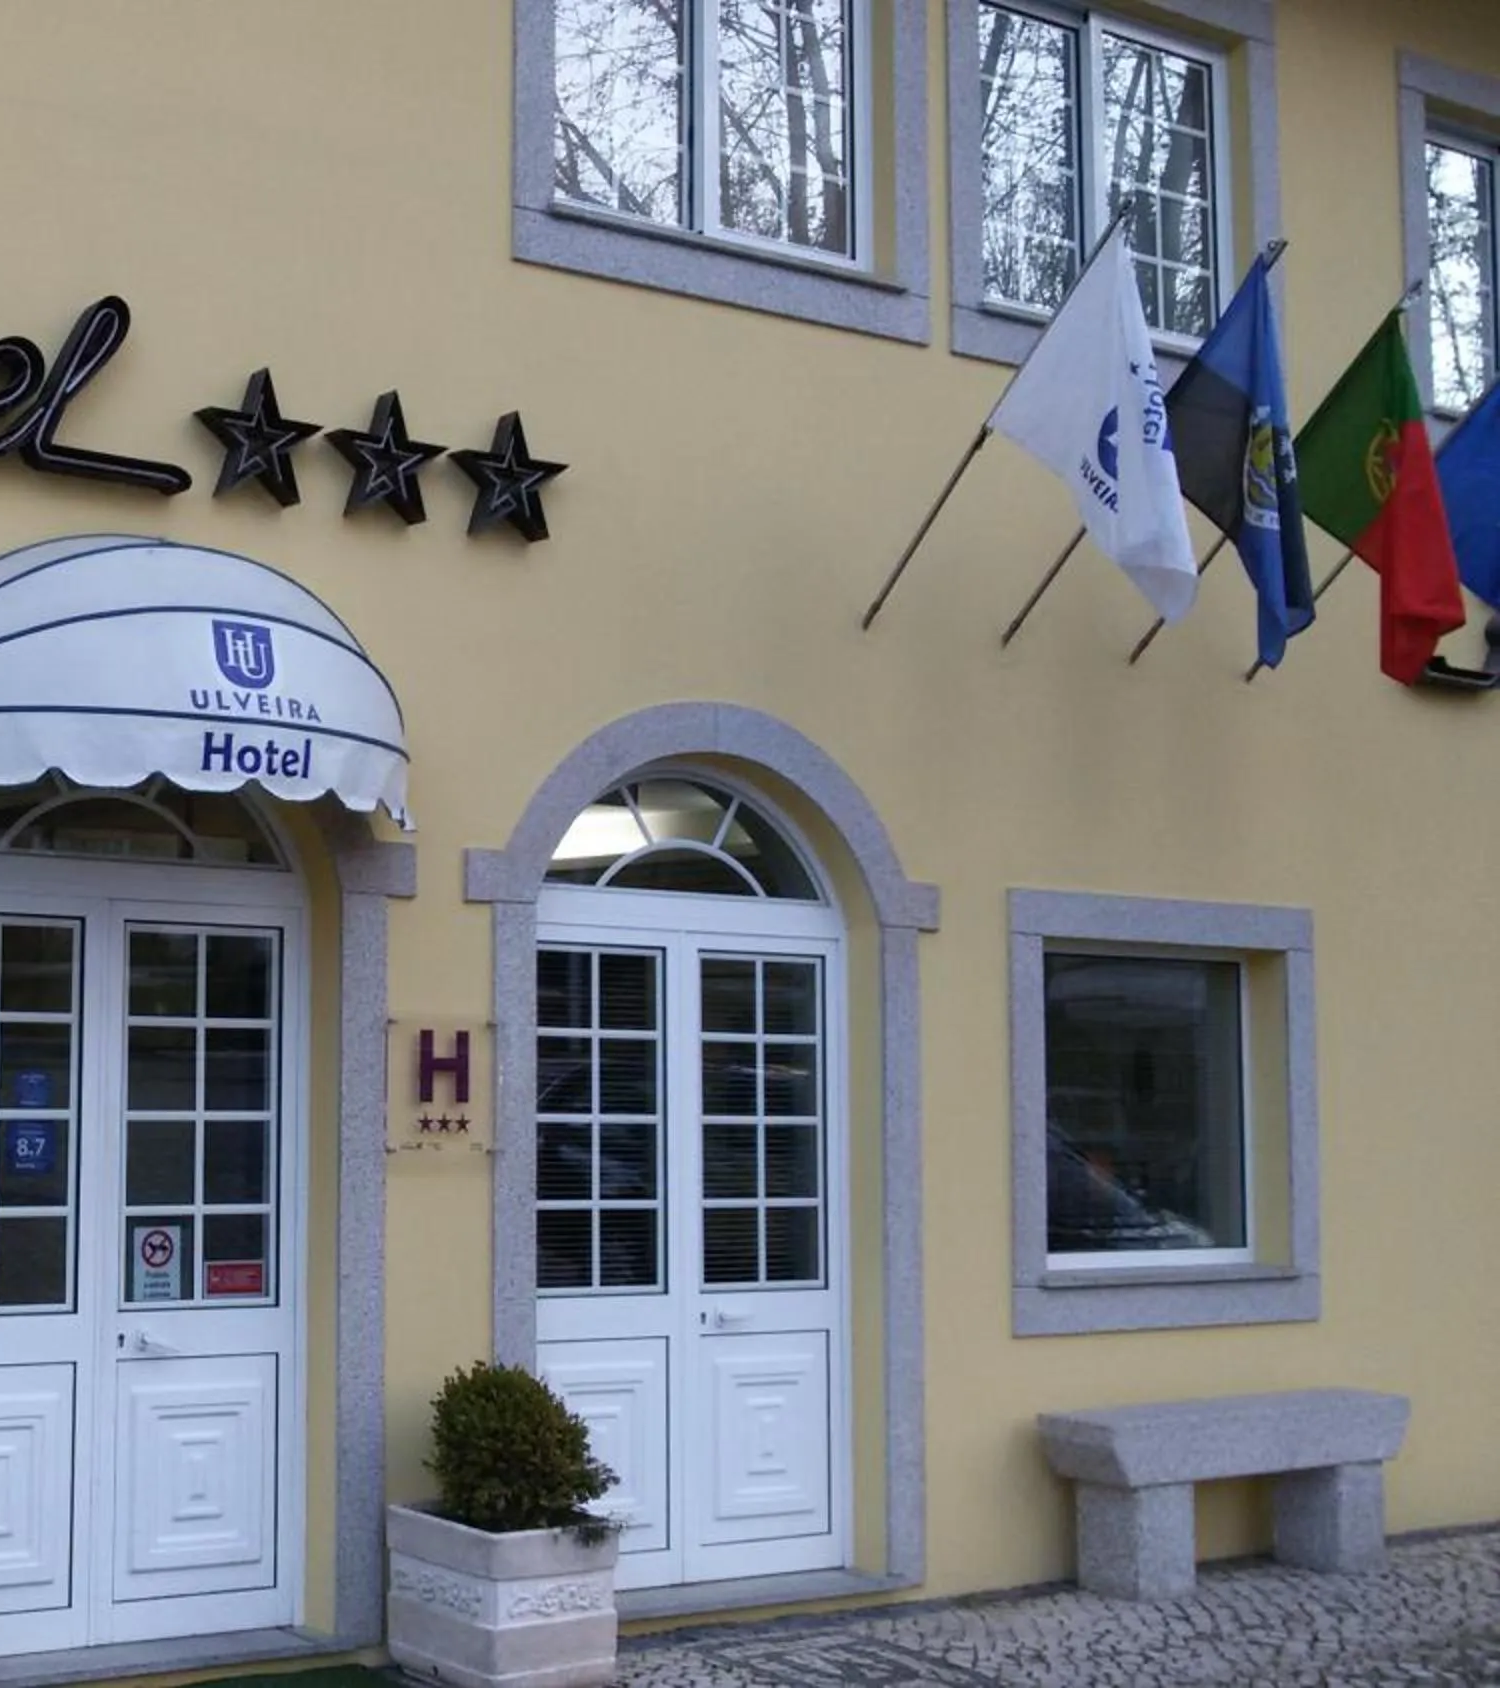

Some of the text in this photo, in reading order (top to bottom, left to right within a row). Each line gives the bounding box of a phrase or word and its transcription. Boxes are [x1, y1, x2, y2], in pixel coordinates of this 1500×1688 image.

[190, 689, 321, 723] ULVEIRA
[201, 731, 311, 778] Hotel
[420, 1030, 469, 1103] H
